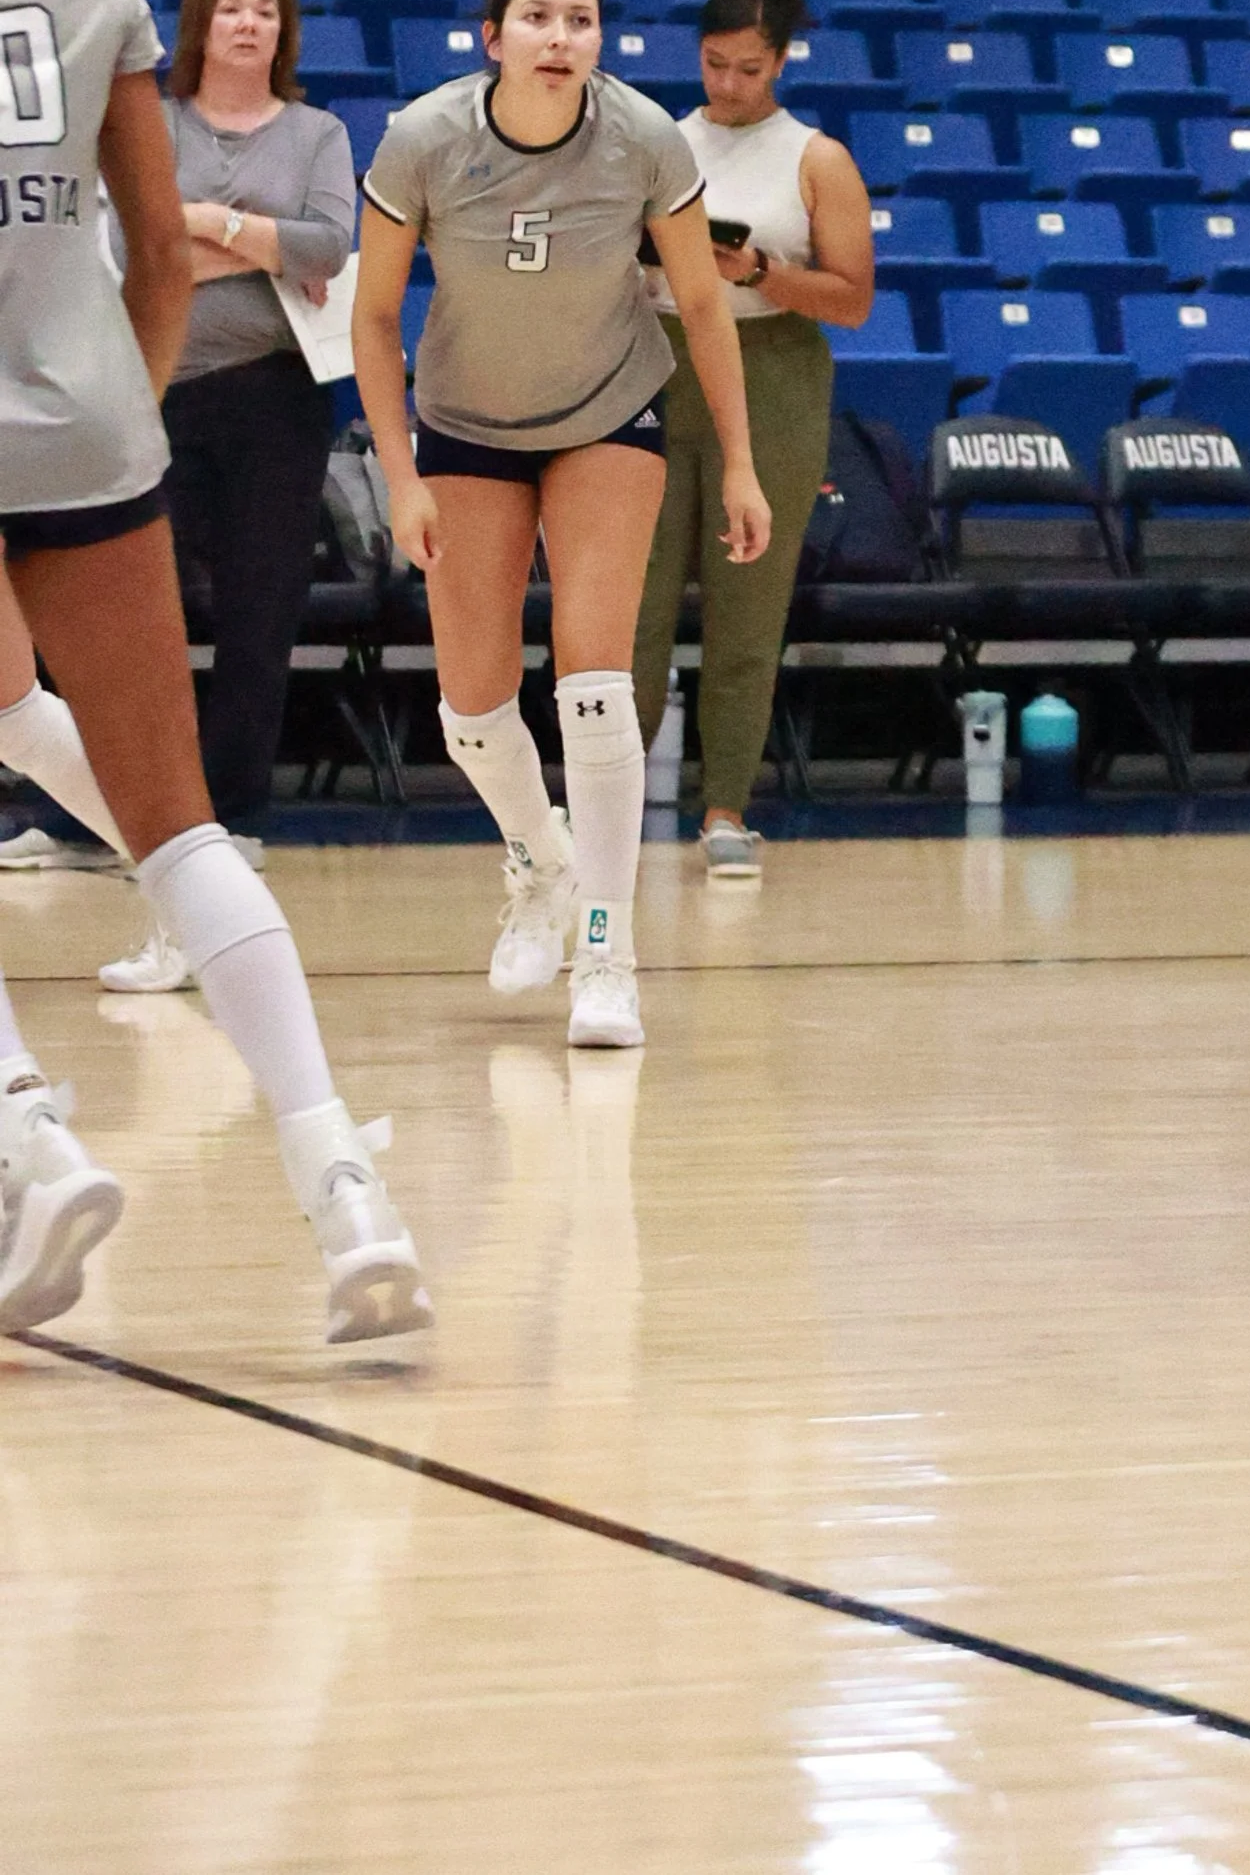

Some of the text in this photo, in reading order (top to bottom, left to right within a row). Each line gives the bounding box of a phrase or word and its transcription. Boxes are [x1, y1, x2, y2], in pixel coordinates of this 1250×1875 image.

[505, 209, 551, 272] 5
[947, 433, 1071, 472] AUGUSTA
[1123, 433, 1242, 470] AUGUSTA
